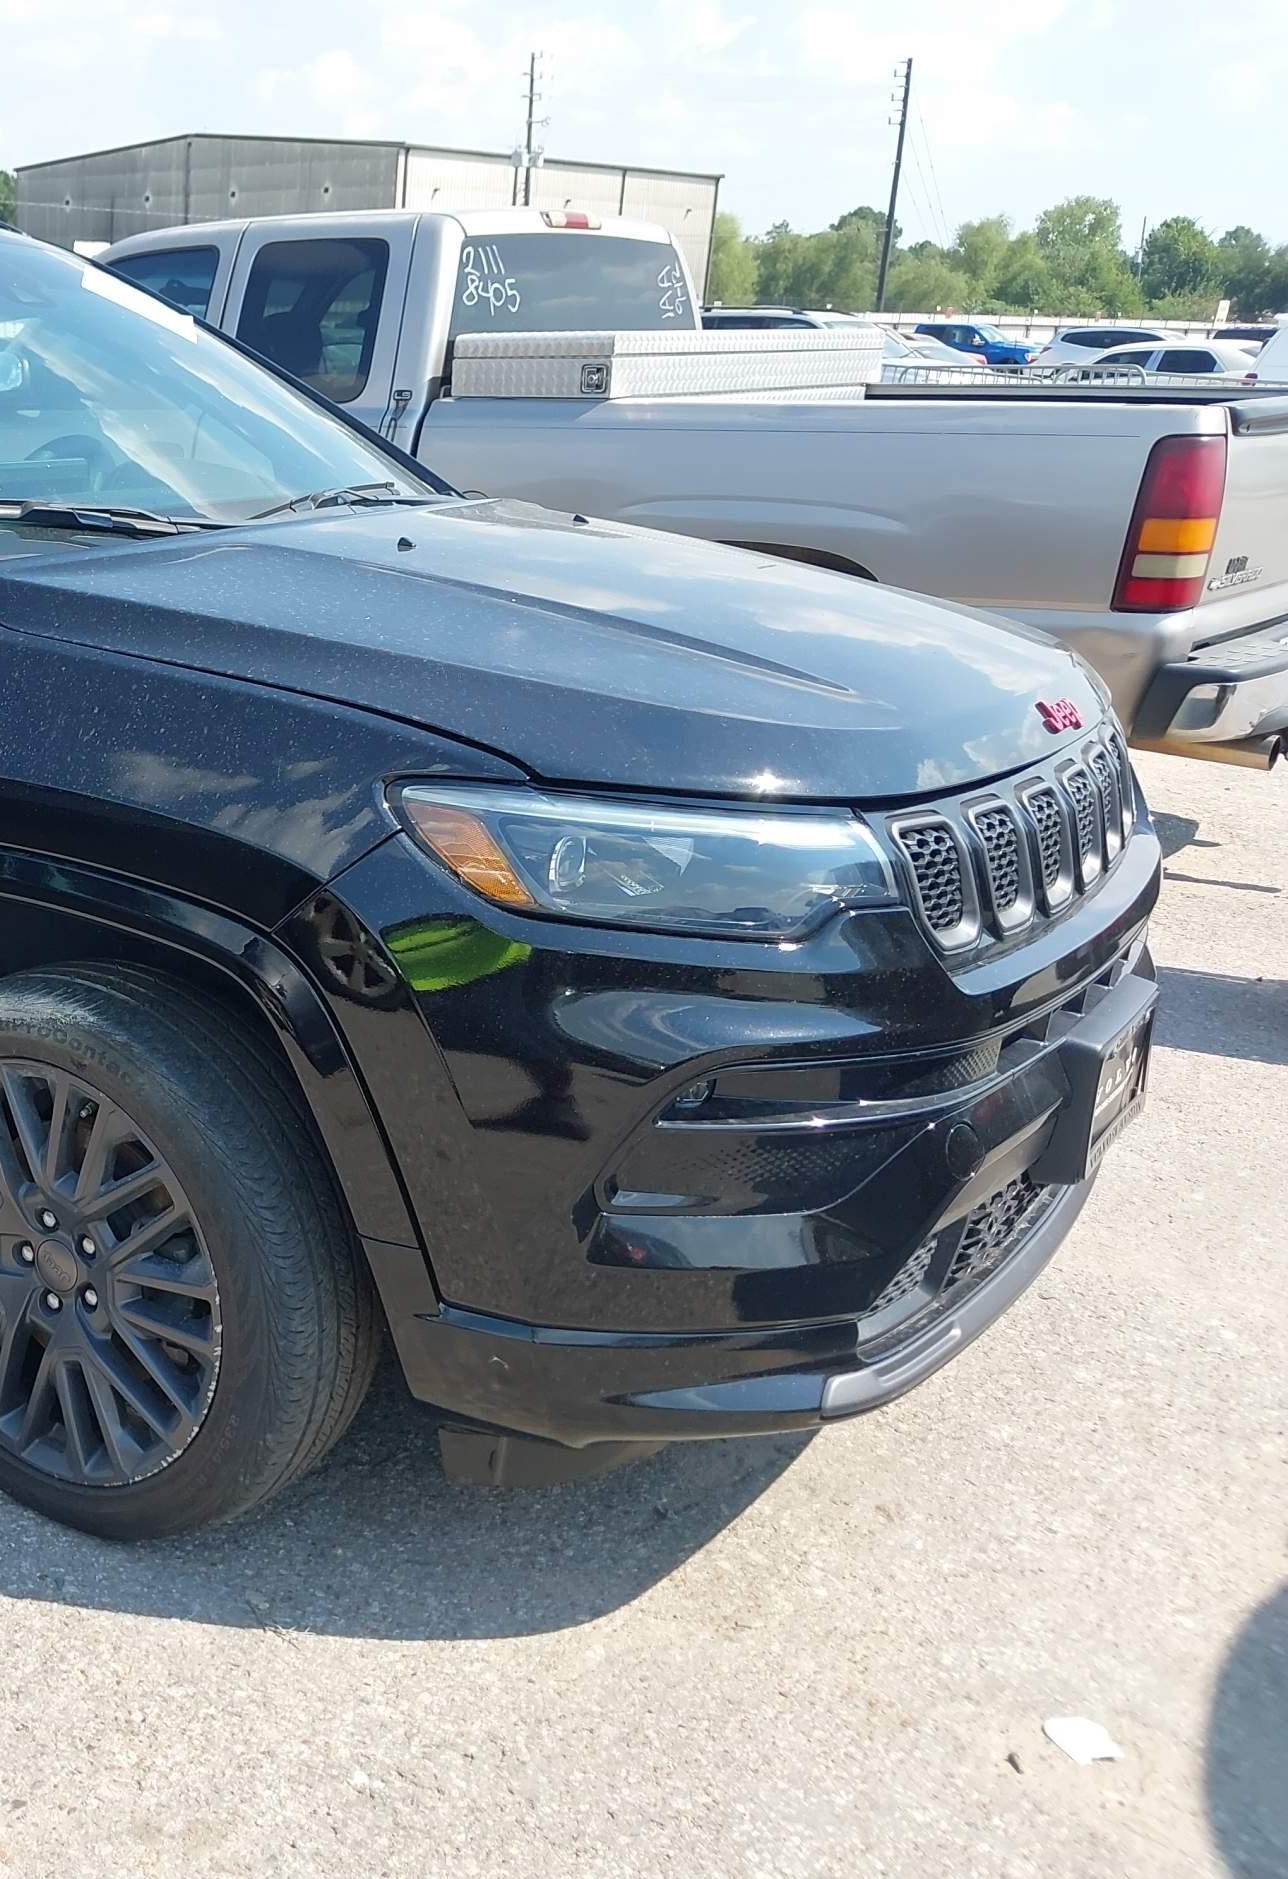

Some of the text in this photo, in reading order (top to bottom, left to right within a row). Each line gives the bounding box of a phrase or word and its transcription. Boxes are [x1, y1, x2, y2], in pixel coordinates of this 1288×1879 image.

[462, 244, 505, 276] 2111
[462, 275, 521, 317] 8405
[1034, 698, 1082, 735] Jeep
